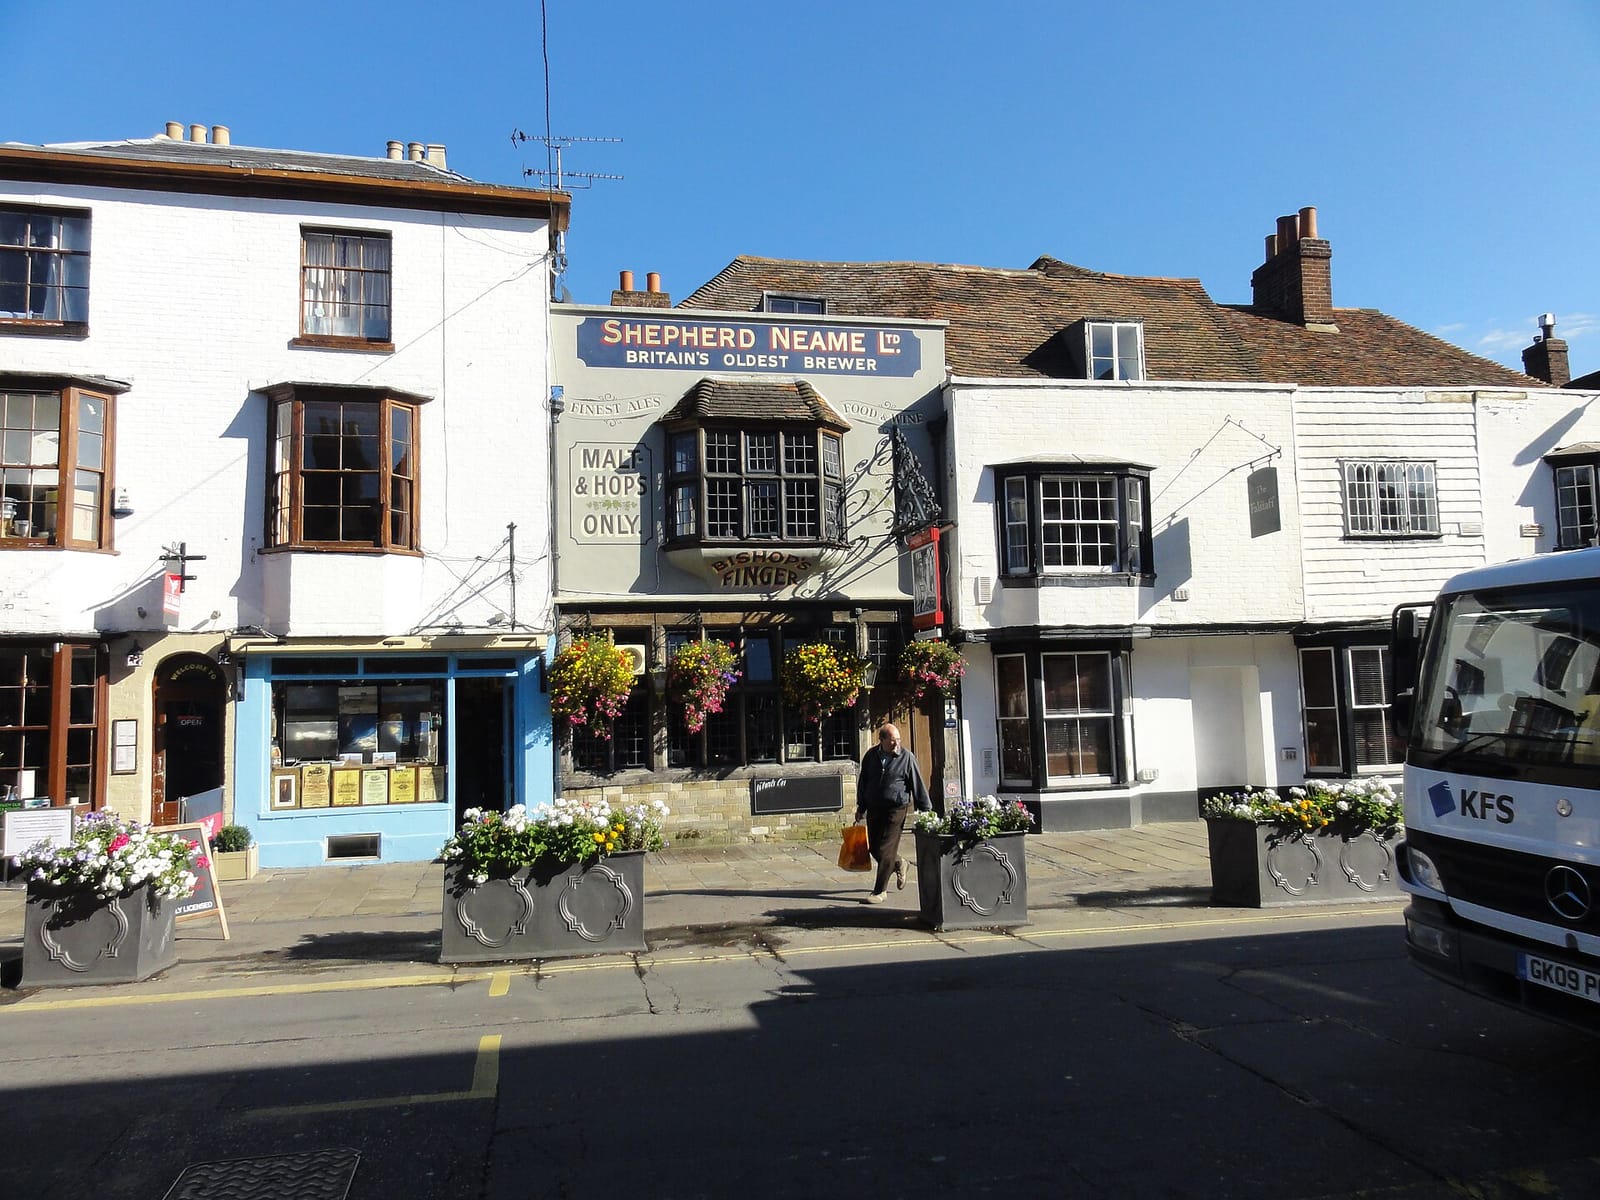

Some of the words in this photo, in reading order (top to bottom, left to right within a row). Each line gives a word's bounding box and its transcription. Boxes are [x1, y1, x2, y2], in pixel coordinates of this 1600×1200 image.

[601, 320, 756, 349] SHEPHERD
[770, 327, 866, 352] NEAME
[626, 350, 709, 365] BRITAIN'S
[723, 353, 789, 368] OLDEST
[804, 356, 877, 371] BREWER
[570, 402, 621, 416] FINEST
[627, 397, 661, 412] ALES
[843, 403, 877, 418] FOOD
[891, 413, 924, 426] WINE
[575, 476, 588, 495] &
[594, 475, 648, 496] HOPS
[722, 566, 799, 587] FINGER
[170, 663, 208, 680] WELCOME
[208, 670, 217, 680] TO
[1460, 789, 1515, 824] KFS
[183, 901, 213, 913] LICENSED
[1530, 959, 1579, 991] GK09
